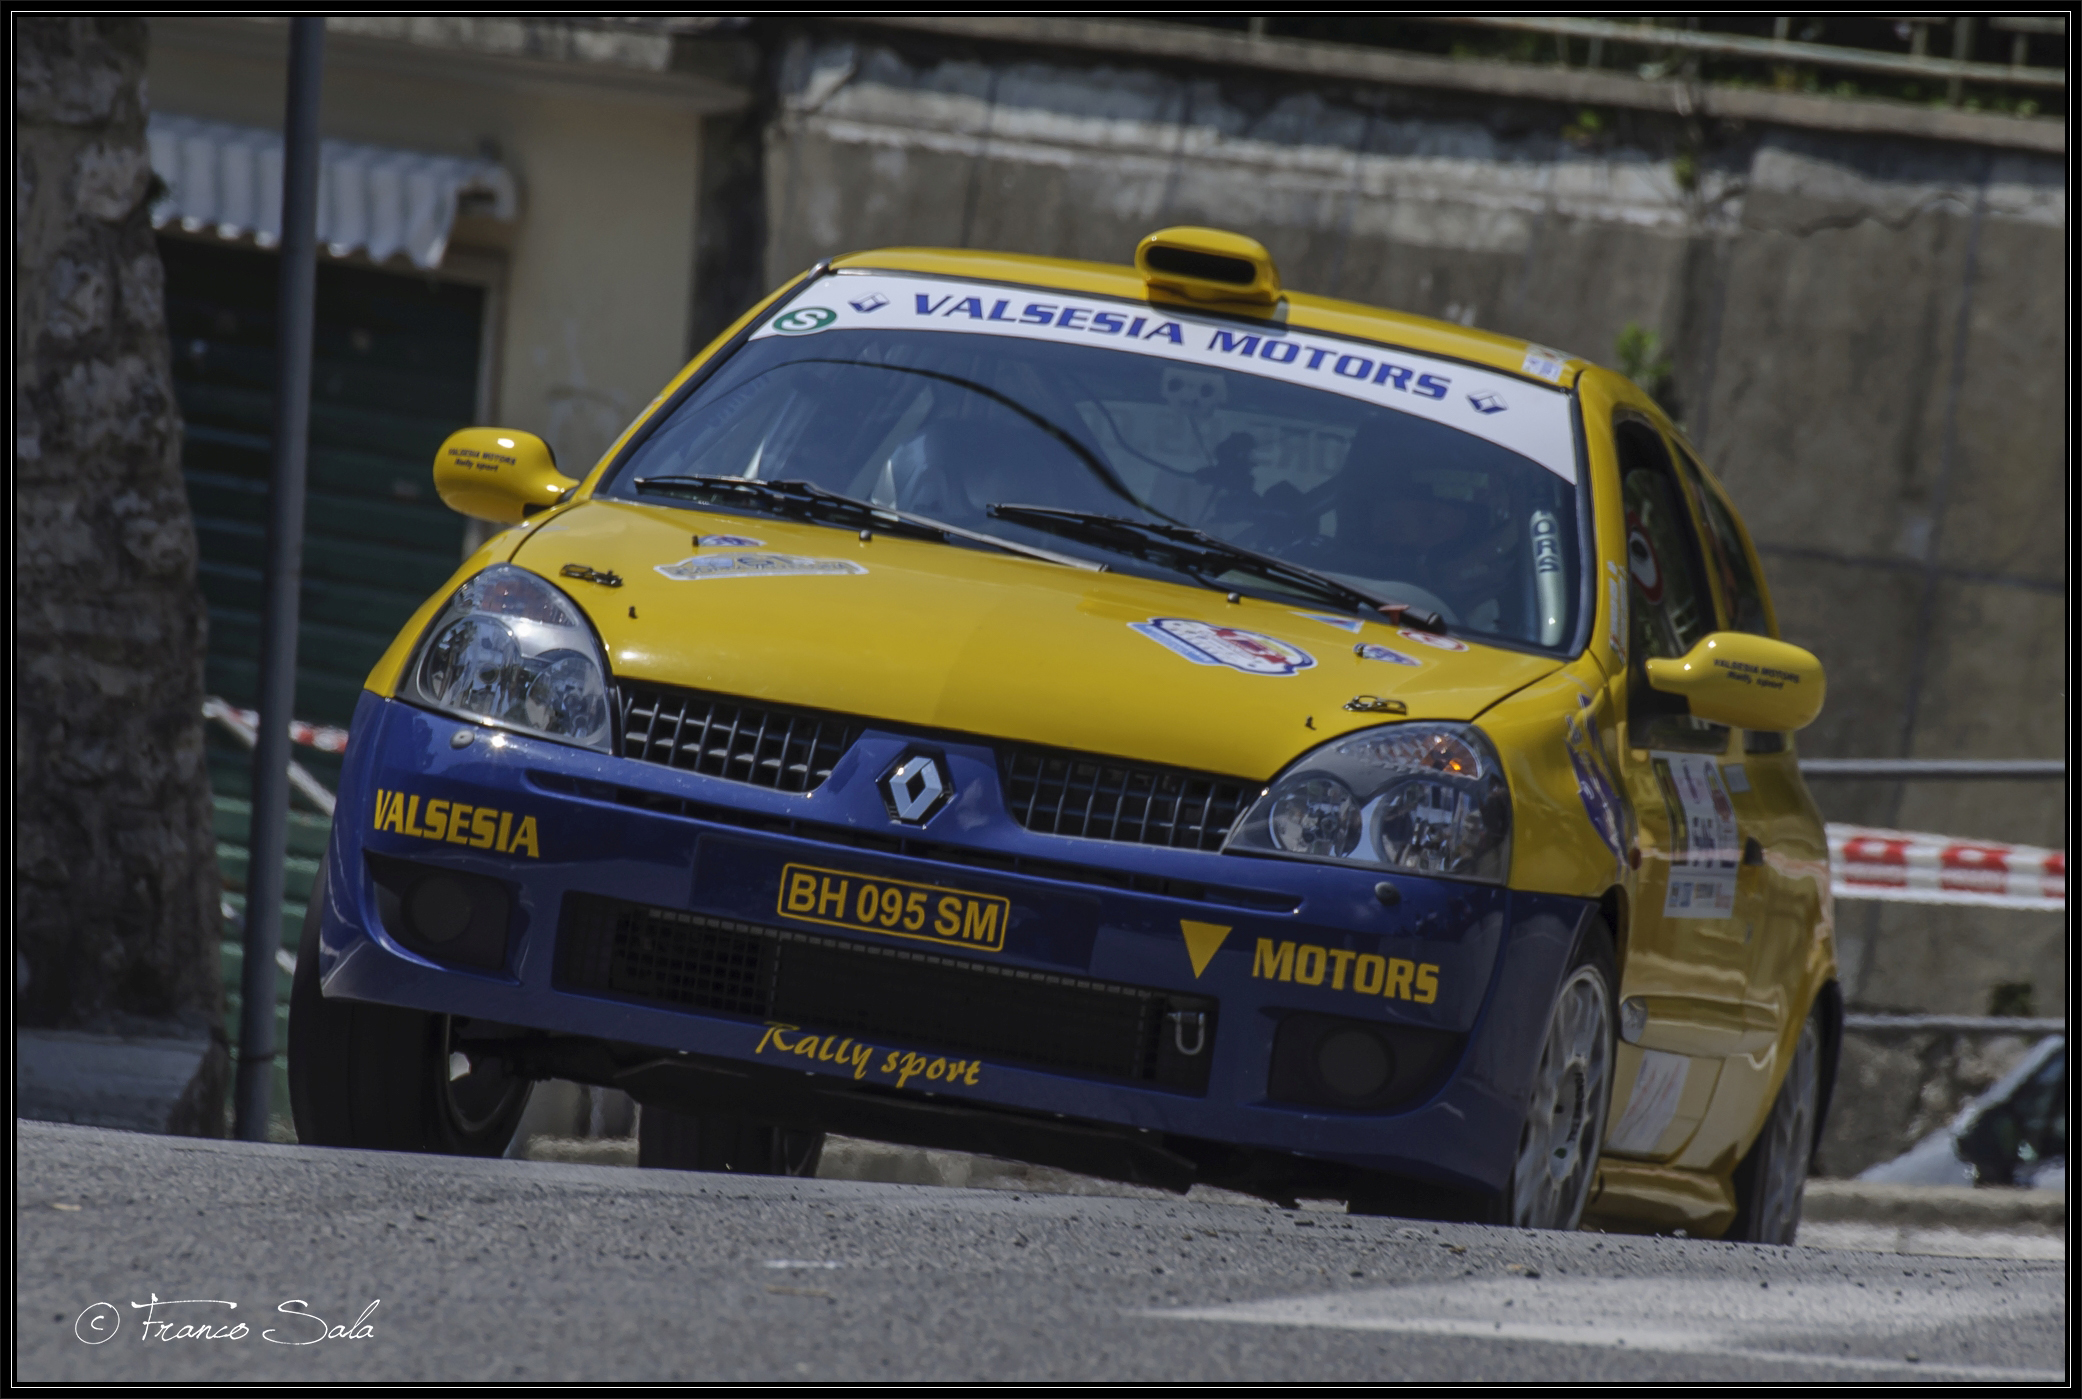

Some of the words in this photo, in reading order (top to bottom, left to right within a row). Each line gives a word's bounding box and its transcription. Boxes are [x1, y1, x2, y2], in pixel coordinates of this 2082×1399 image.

[914, 292, 1184, 346] VALSESIA
[1206, 330, 1453, 401] MOTORS
[373, 788, 540, 859] VALSESIA
[787, 872, 849, 918] BH
[856, 884, 928, 931] 095
[934, 896, 999, 942] SM
[1252, 937, 1440, 1005] MOTORS
[755, 1020, 874, 1080] Rally
[881, 1051, 981, 1088] sport
